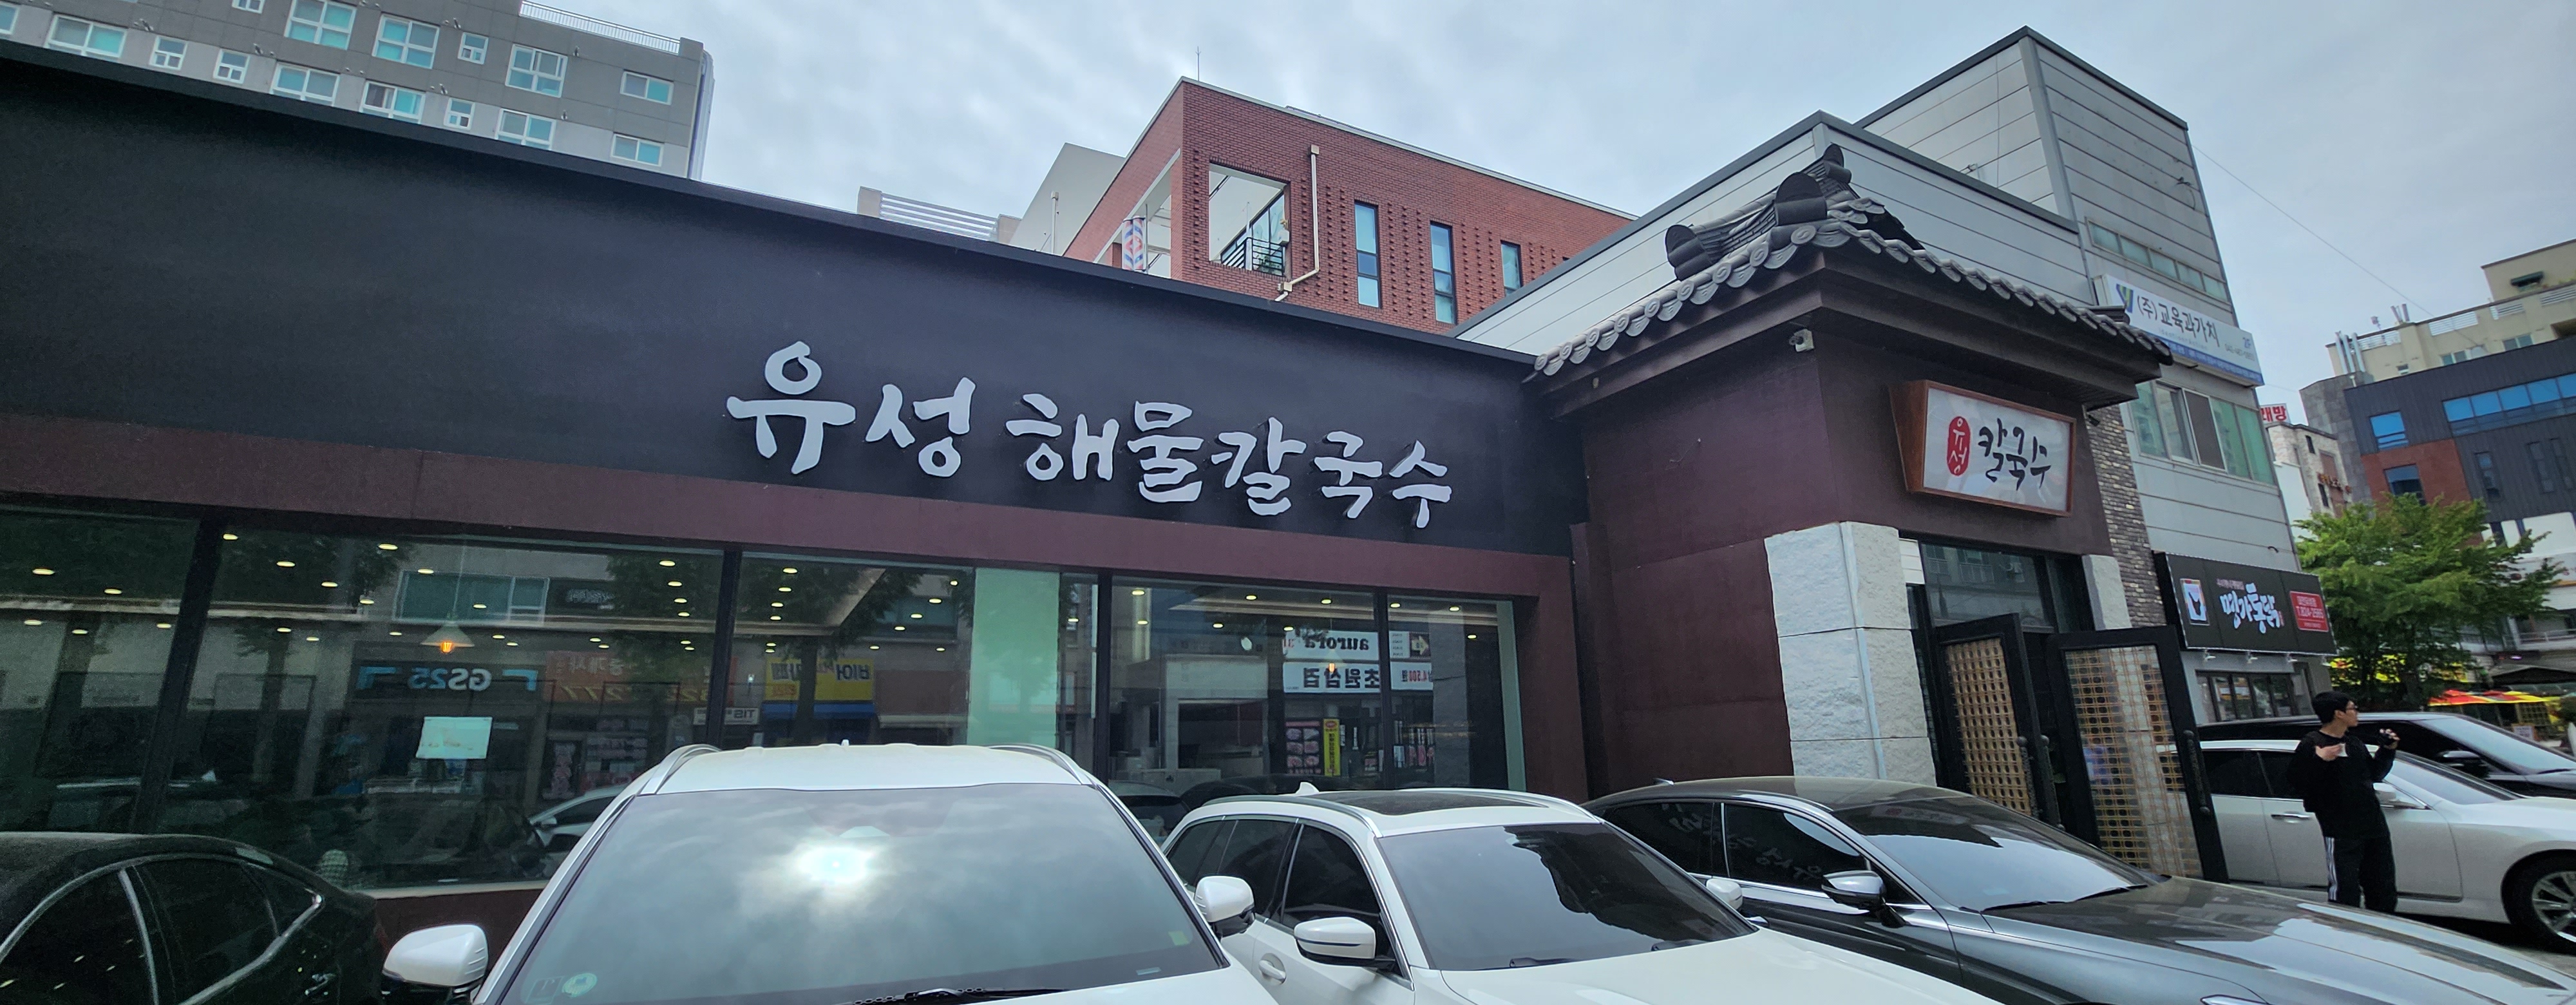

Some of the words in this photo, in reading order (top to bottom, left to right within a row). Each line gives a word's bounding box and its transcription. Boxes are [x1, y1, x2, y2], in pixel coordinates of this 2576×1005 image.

[2137, 296, 2221, 347] (주)교육과가치
[726, 341, 975, 477] 유성
[1006, 393, 1451, 528] 해물칼국수
[1948, 417, 1968, 474] 유성
[1978, 417, 2051, 491] 칼국수
